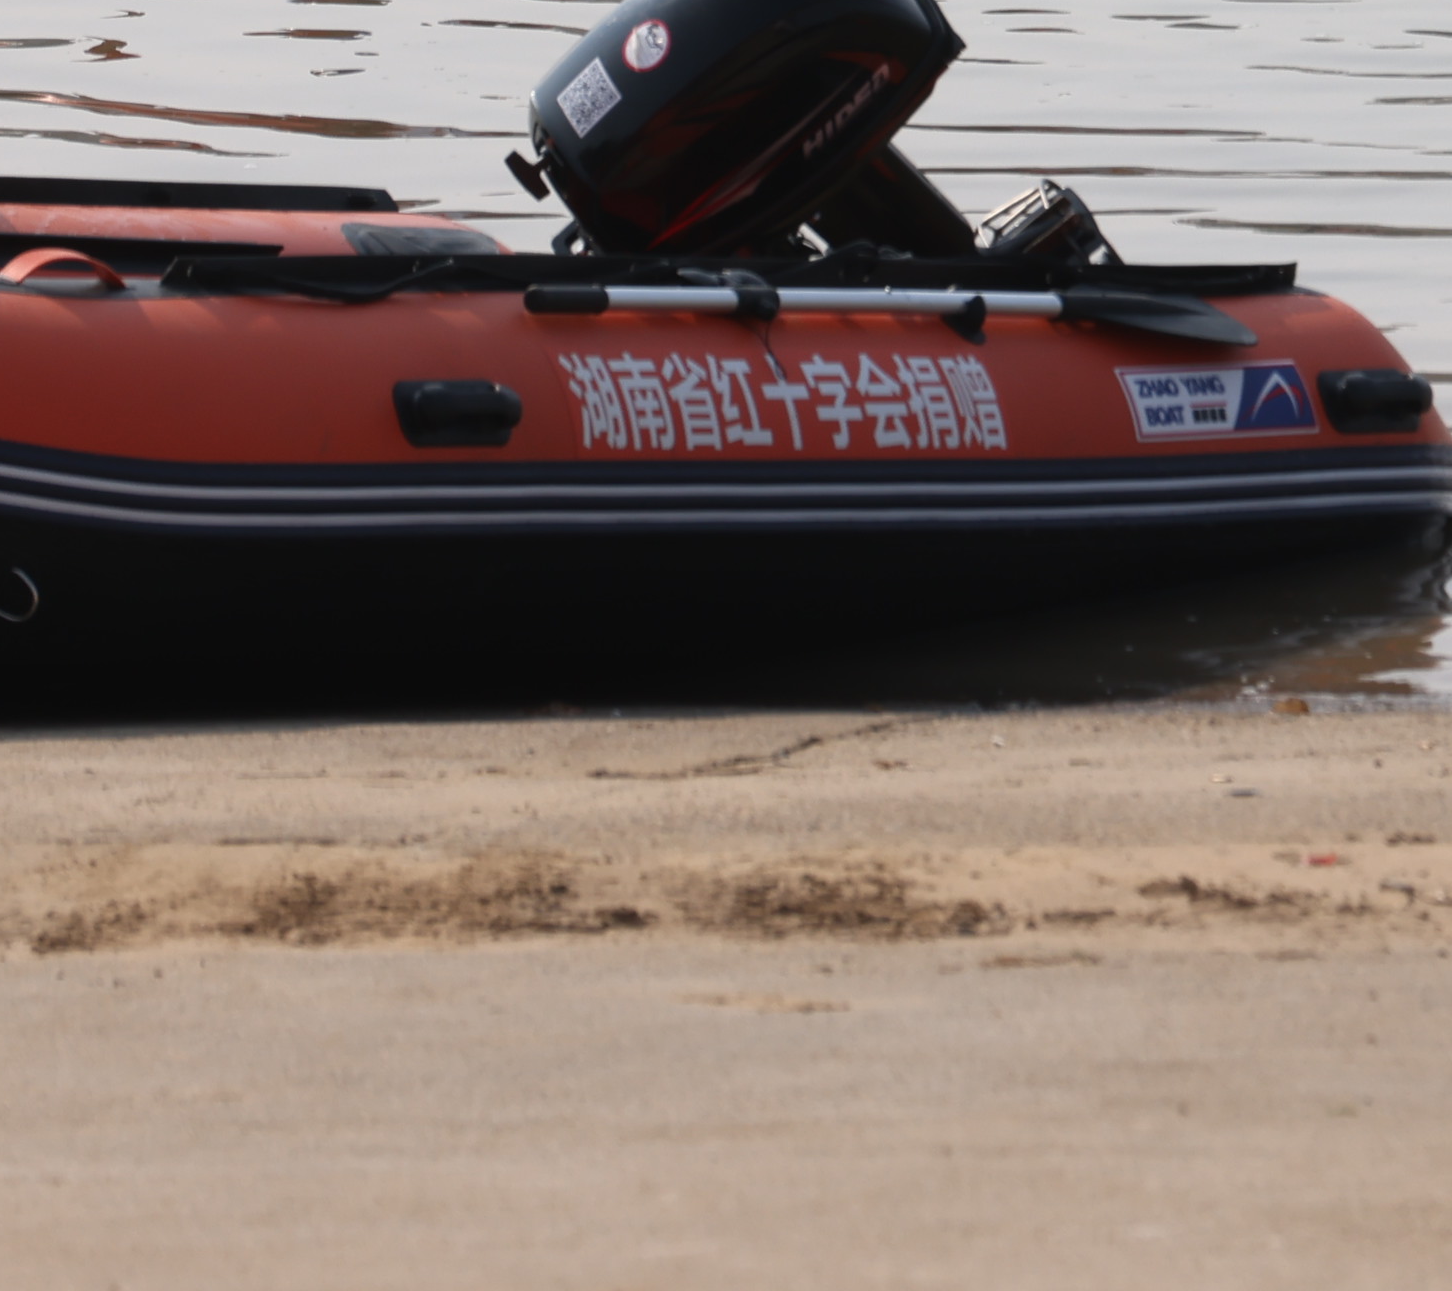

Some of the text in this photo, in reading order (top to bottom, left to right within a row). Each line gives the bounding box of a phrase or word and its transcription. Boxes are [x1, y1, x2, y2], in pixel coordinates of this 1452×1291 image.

[1134, 375, 1225, 399] ZHAO YANG
[558, 351, 1008, 452] 湖南省红十字会捐赠
[1145, 406, 1184, 426] BOAT
